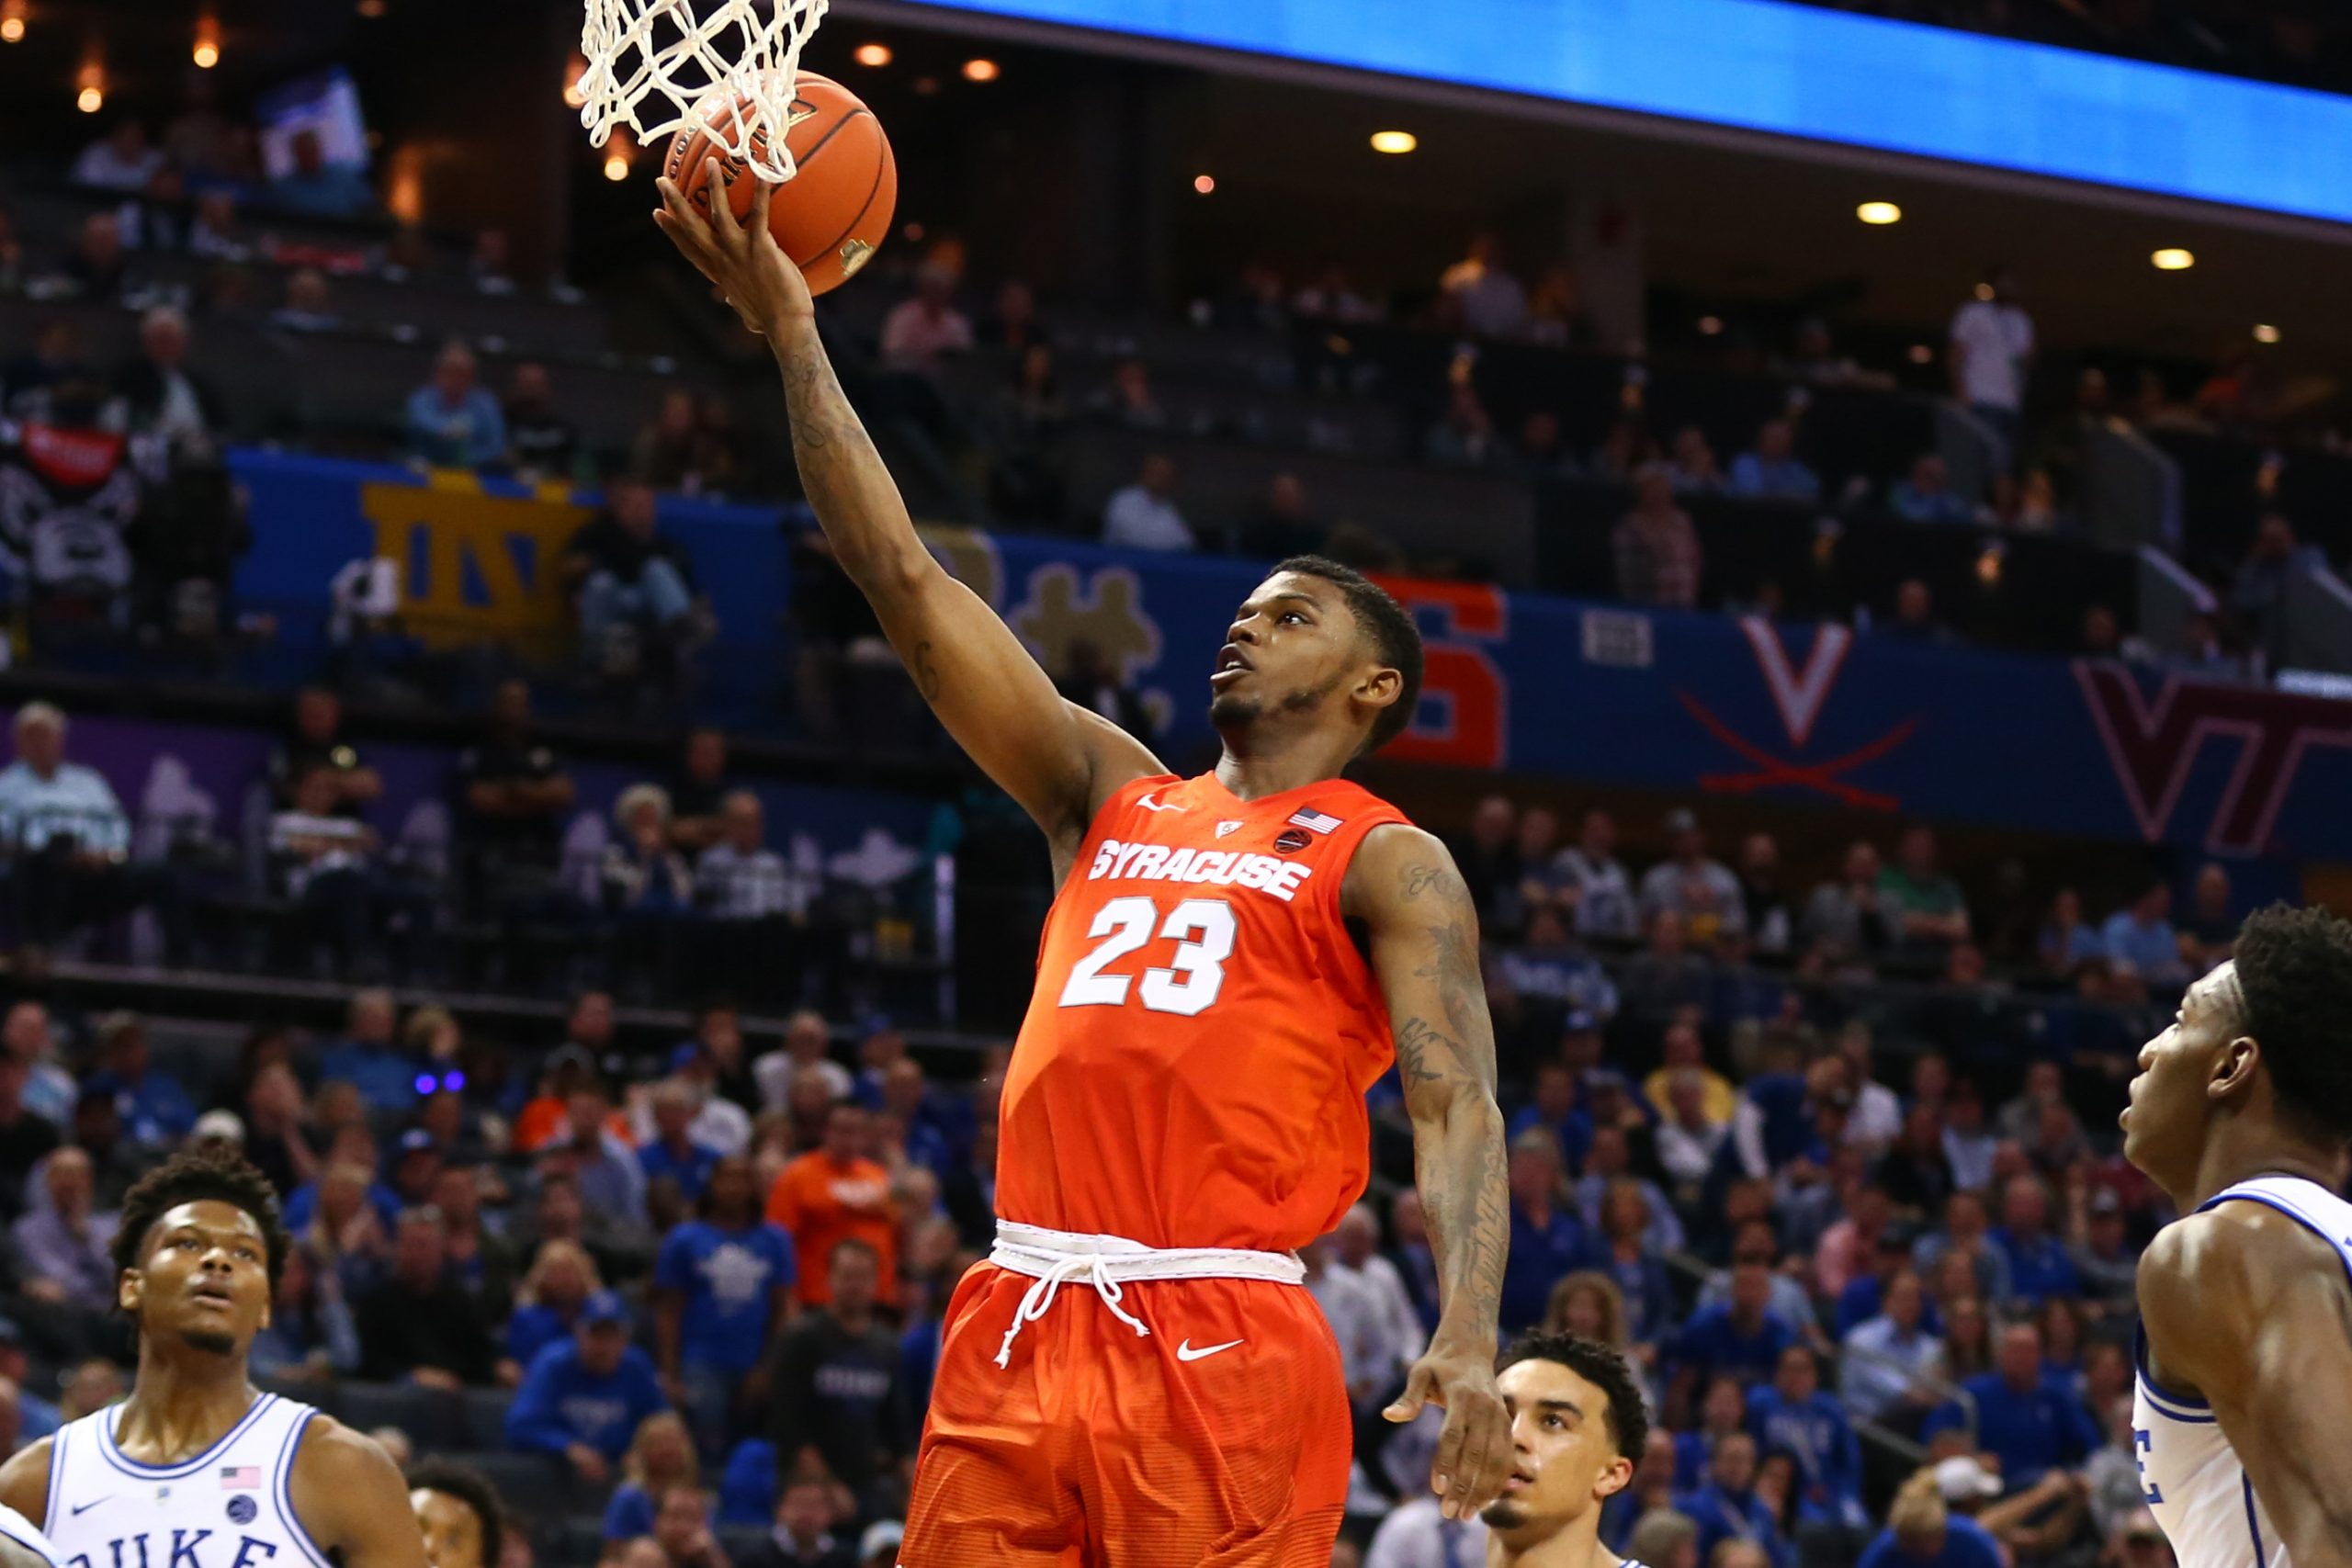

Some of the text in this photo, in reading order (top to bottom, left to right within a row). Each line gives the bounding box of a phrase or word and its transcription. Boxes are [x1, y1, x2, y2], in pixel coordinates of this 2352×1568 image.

[1738, 612, 1854, 746] V
[2073, 658, 2352, 858] VT
[1088, 839, 1313, 902] SYRACUSE
[1058, 896, 1238, 1016] 23
[68, 1530, 277, 1568] UKE
